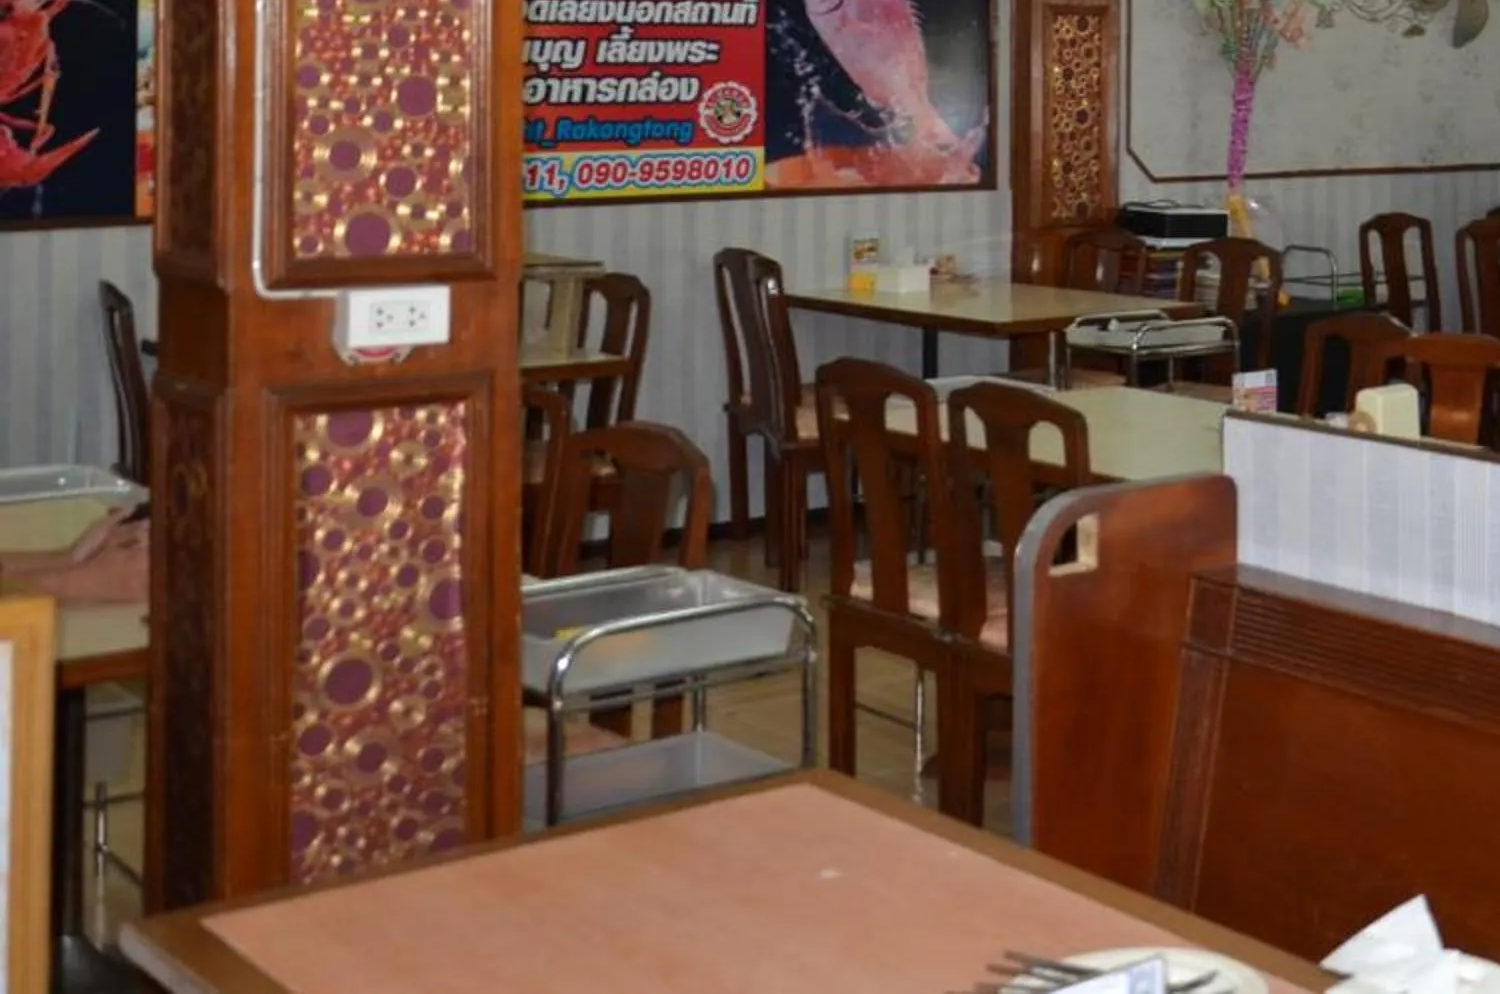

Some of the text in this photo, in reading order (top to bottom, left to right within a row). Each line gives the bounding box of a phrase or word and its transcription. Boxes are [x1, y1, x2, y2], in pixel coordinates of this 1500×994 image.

[521, 27, 720, 72] บุญ เลี้ยงพระ
[577, 157, 751, 186] 090-9598010
